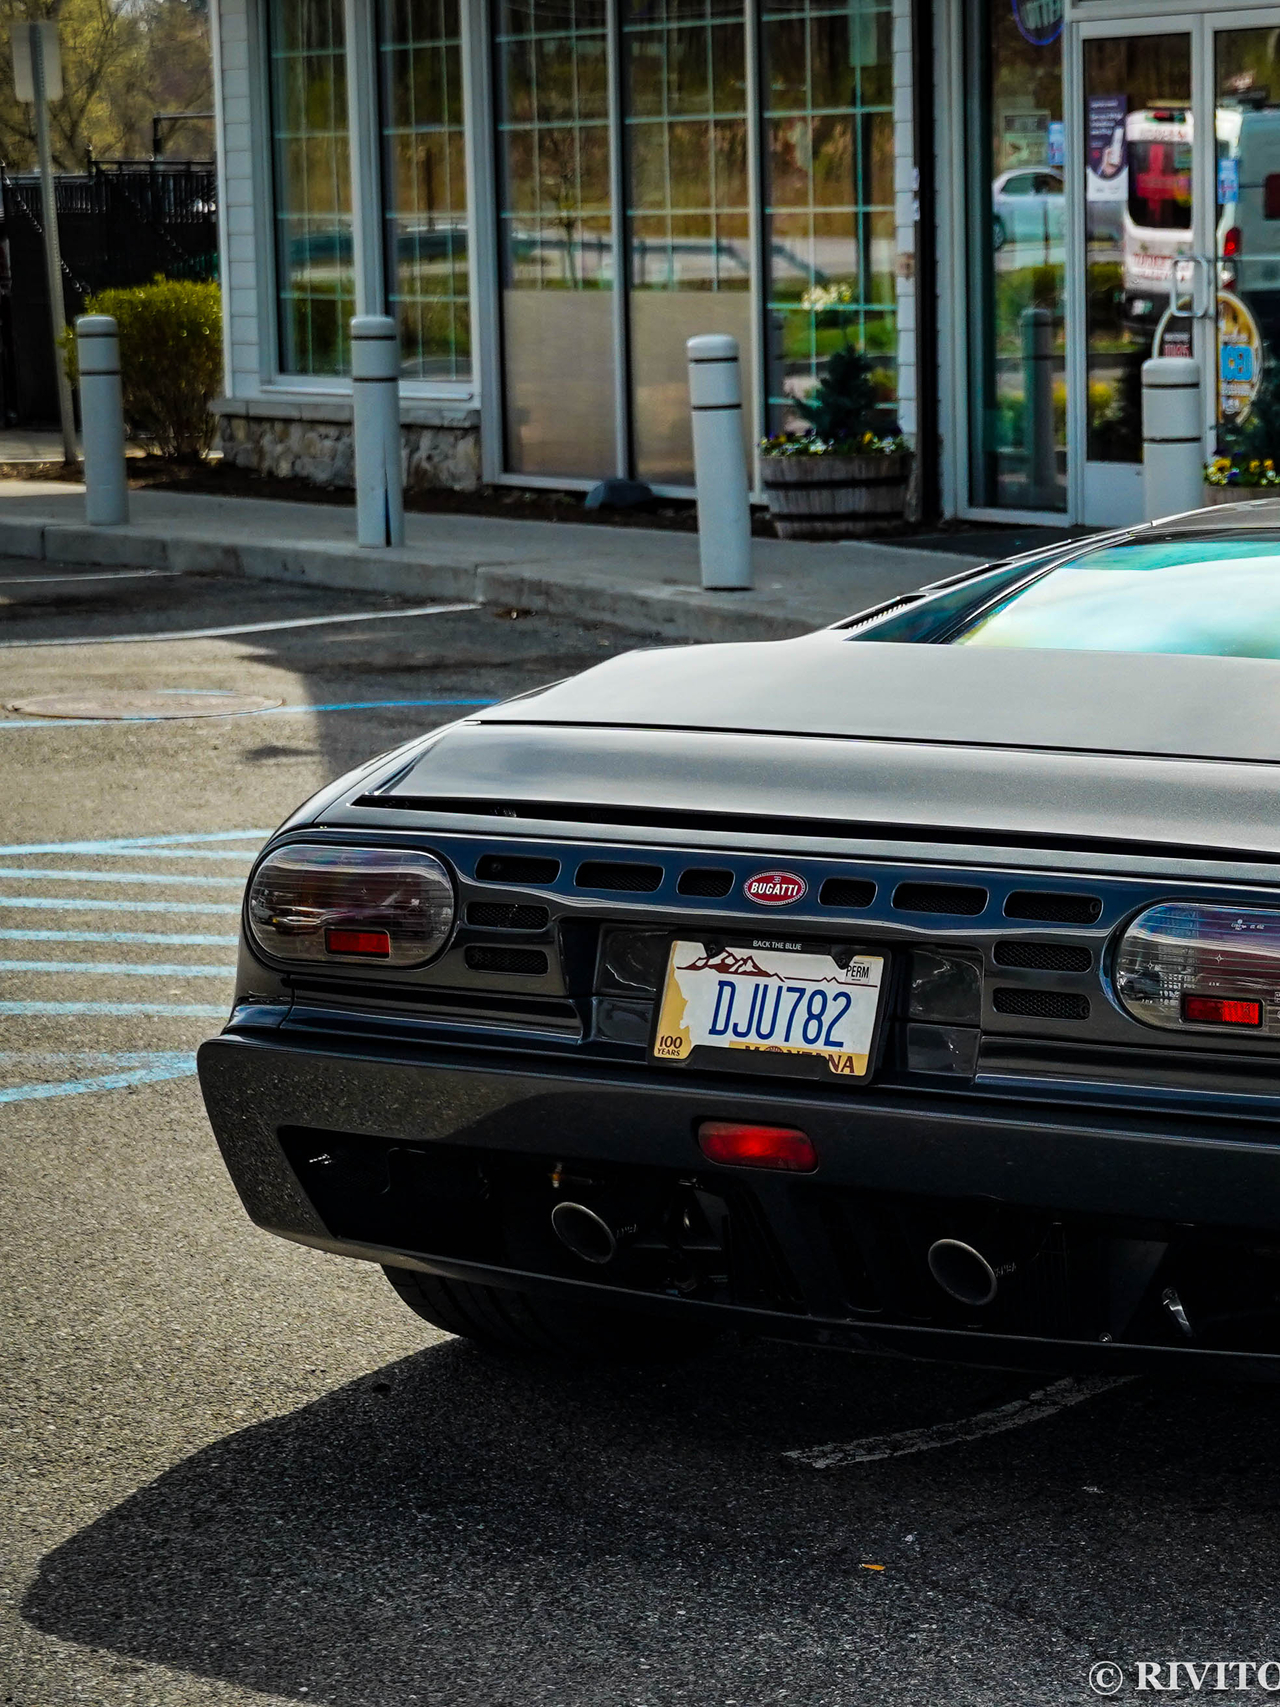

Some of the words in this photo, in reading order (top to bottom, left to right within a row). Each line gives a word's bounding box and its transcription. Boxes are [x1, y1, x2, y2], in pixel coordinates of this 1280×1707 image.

[750, 882, 799, 897] BUGATTI
[752, 939, 771, 949] BACK
[771, 941, 784, 949] THE
[785, 942, 802, 951] BLUE
[845, 964, 870, 979] PERM
[708, 980, 852, 1048] DJU782
[659, 1035, 683, 1049] 100
[657, 1048, 681, 1057] YEARS
